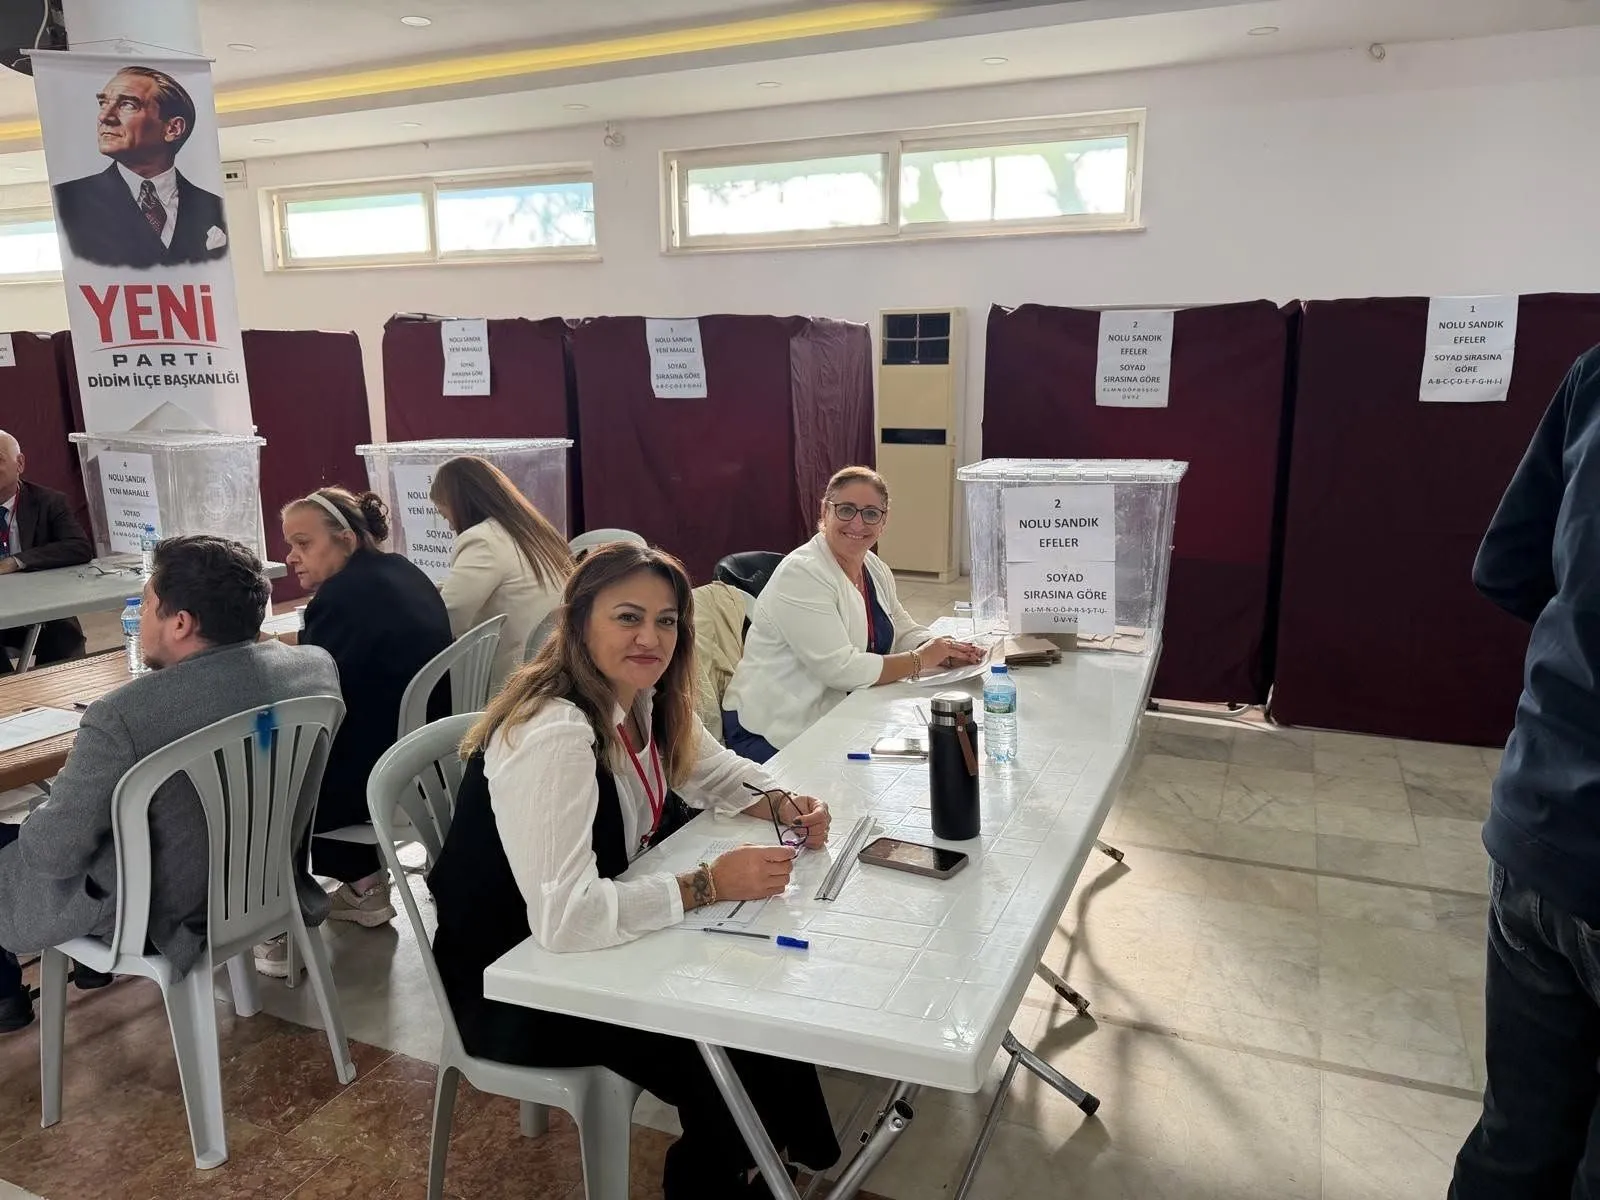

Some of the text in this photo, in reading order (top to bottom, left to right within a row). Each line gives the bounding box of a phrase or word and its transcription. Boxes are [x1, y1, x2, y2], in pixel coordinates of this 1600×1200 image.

[1470, 305, 1476, 313] 1
[1132, 321, 1138, 329] 2
[1438, 320, 1504, 329] NOLU SANDIK
[1107, 334, 1162, 342] NOLU SANDIK
[1453, 336, 1486, 344] EFELER
[1120, 348, 1148, 356] EFELER
[1464, 353, 1502, 361] SIRASINA
[1119, 364, 1146, 372] SOYAD
[1454, 364, 1478, 373] GÖRE
[88, 371, 240, 389] DİDİM İLÇE BAŞKANLIĞI
[1139, 375, 1161, 383] GÖRE
[108, 473, 147, 484] NOLU SANDIK
[426, 475, 432, 484] 3
[122, 489, 150, 498] MAHALLE
[407, 491, 428, 500] NOLU
[1054, 498, 1062, 509] 2
[122, 509, 141, 518] SOYAD
[407, 506, 425, 516] YENİ
[114, 520, 137, 529] SIRASINA
[1019, 517, 1099, 529] NOLU SANDIK
[426, 530, 453, 539] SOYAD
[1039, 537, 1079, 548] EFELER
[412, 543, 448, 554] SIRASINA
[1046, 573, 1084, 583] SOYAD
[1023, 588, 1107, 601] SIRASINA GÖRE
